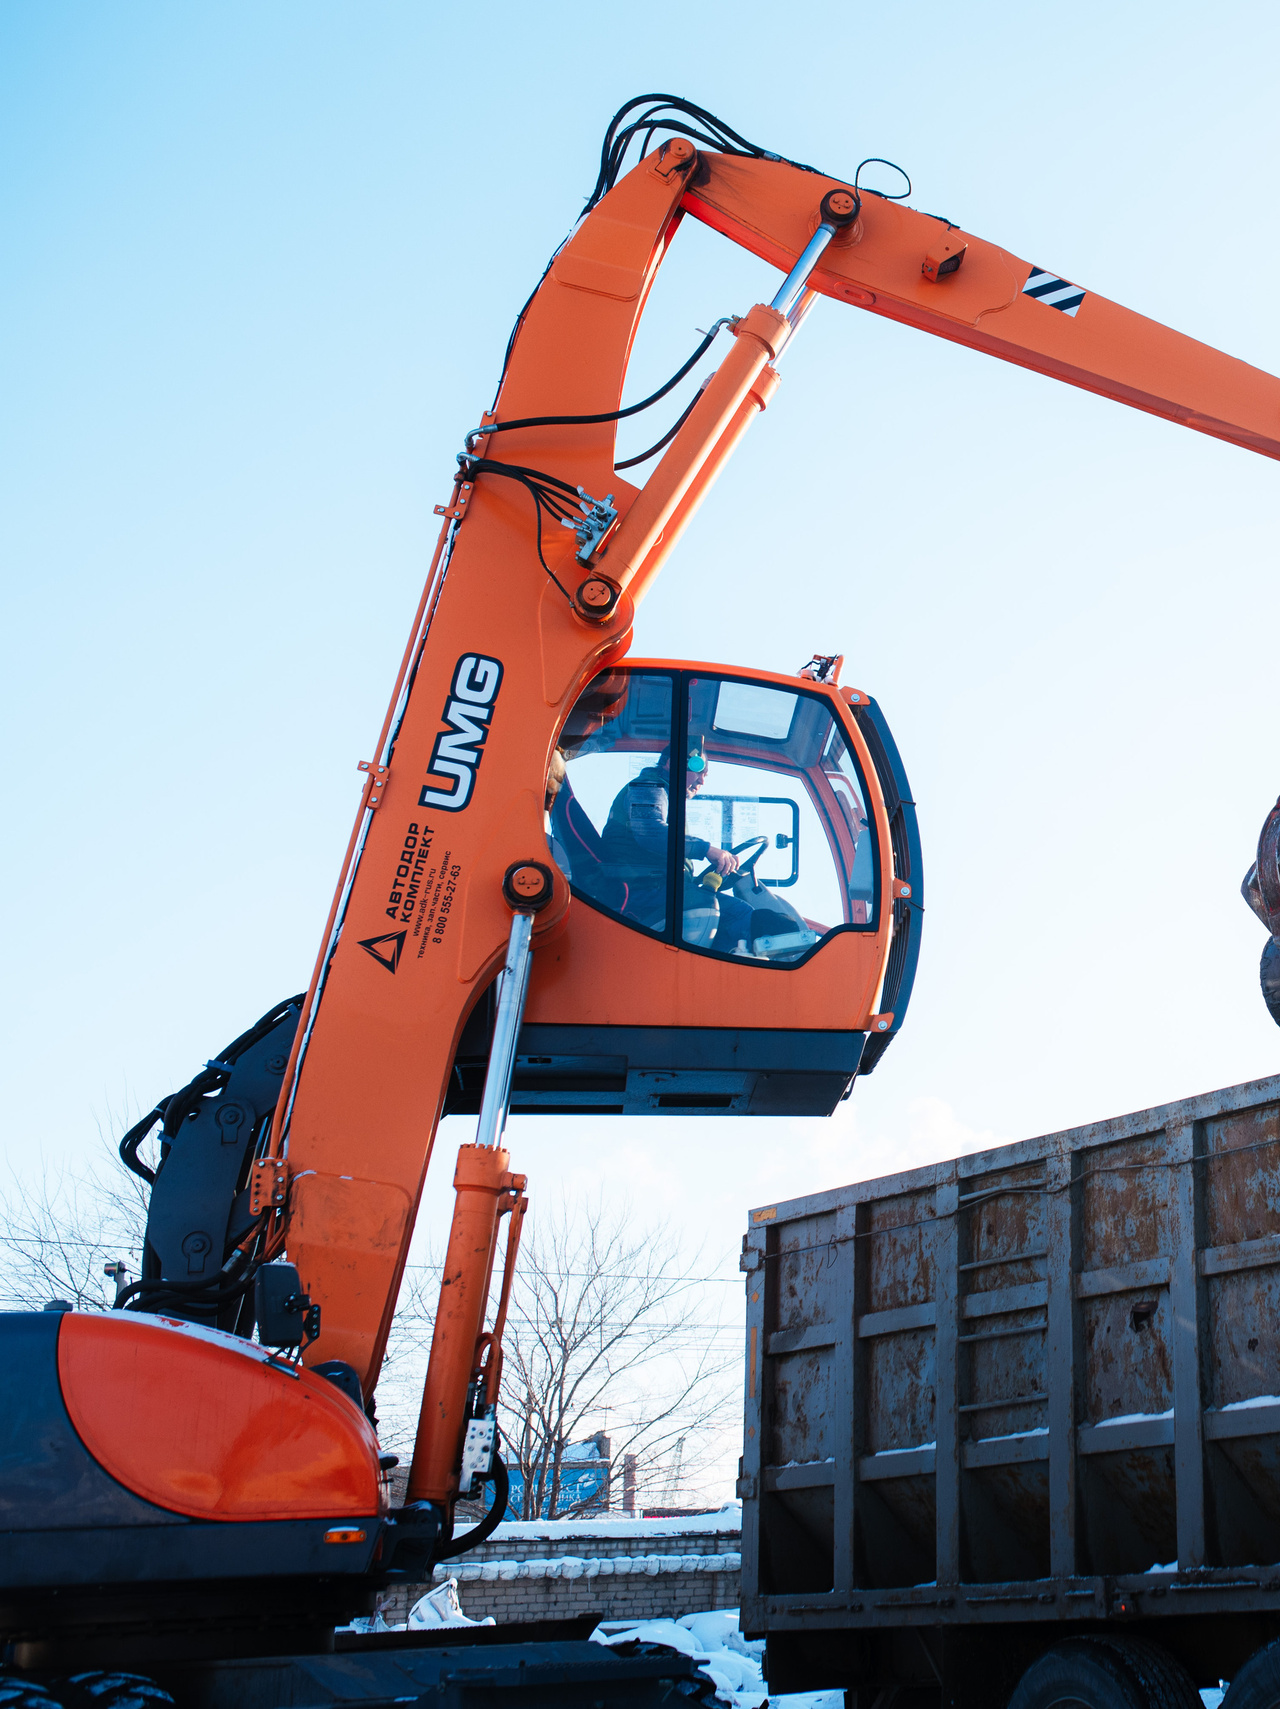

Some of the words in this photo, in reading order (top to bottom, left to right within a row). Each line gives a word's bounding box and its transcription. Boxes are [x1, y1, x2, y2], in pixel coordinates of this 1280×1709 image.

[418, 652, 504, 812] UMG
[386, 823, 419, 920] АВТОДОР
[400, 826, 435, 923] КОМПЛЕКТ
[413, 868, 436, 937] www.adk-rus.ru
[417, 925, 432, 959] техника,
[439, 850, 452, 879] сервис
[440, 865, 461, 914] 555-27-63
[434, 916, 448, 935] 800
